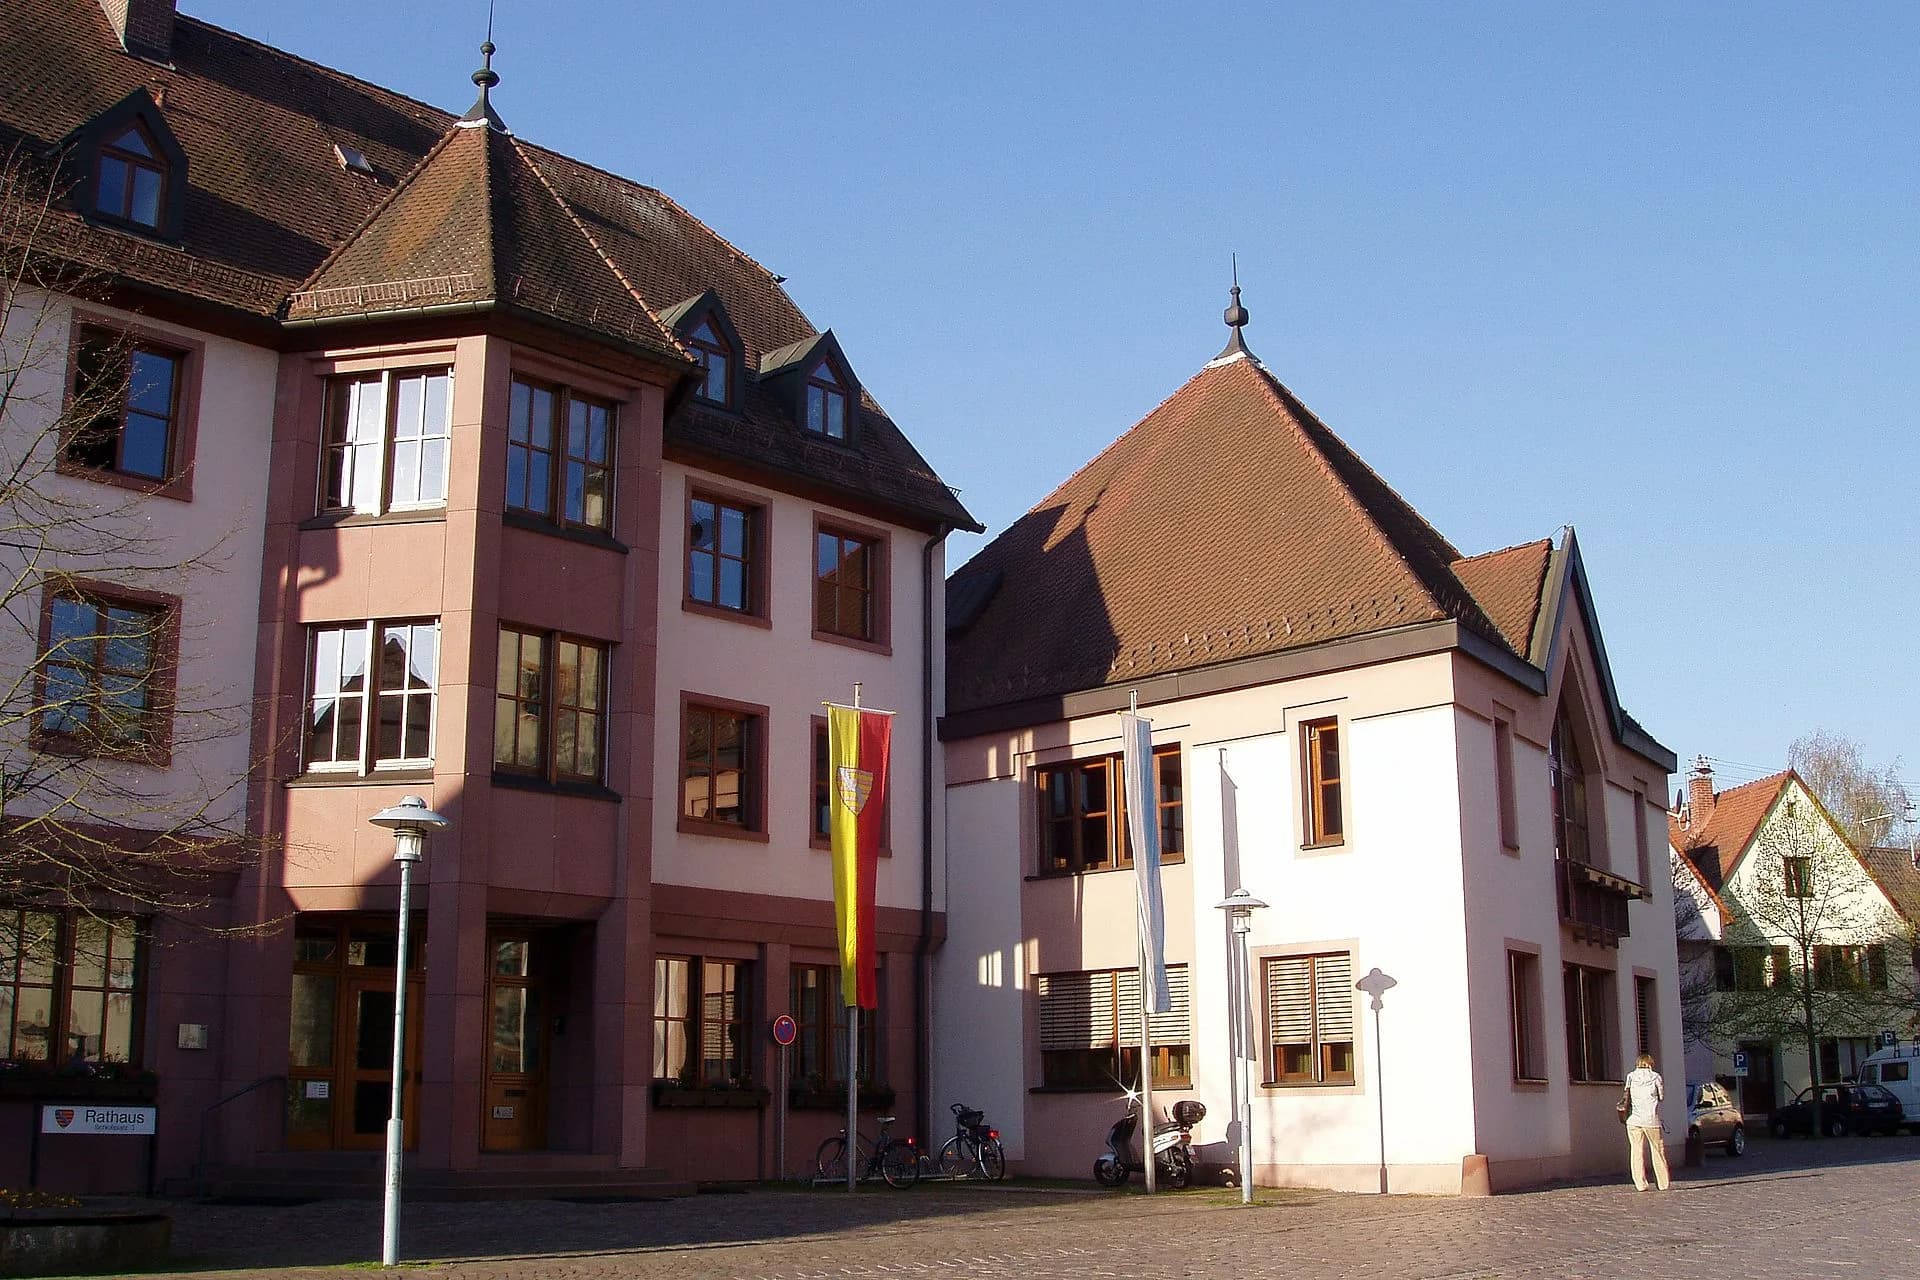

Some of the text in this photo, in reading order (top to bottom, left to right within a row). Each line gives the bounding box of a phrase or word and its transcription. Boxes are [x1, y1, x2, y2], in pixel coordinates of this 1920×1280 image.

[1885, 1033, 1893, 1044] P
[1736, 1054, 1744, 1066] P
[86, 1109, 145, 1124] Rathaus
